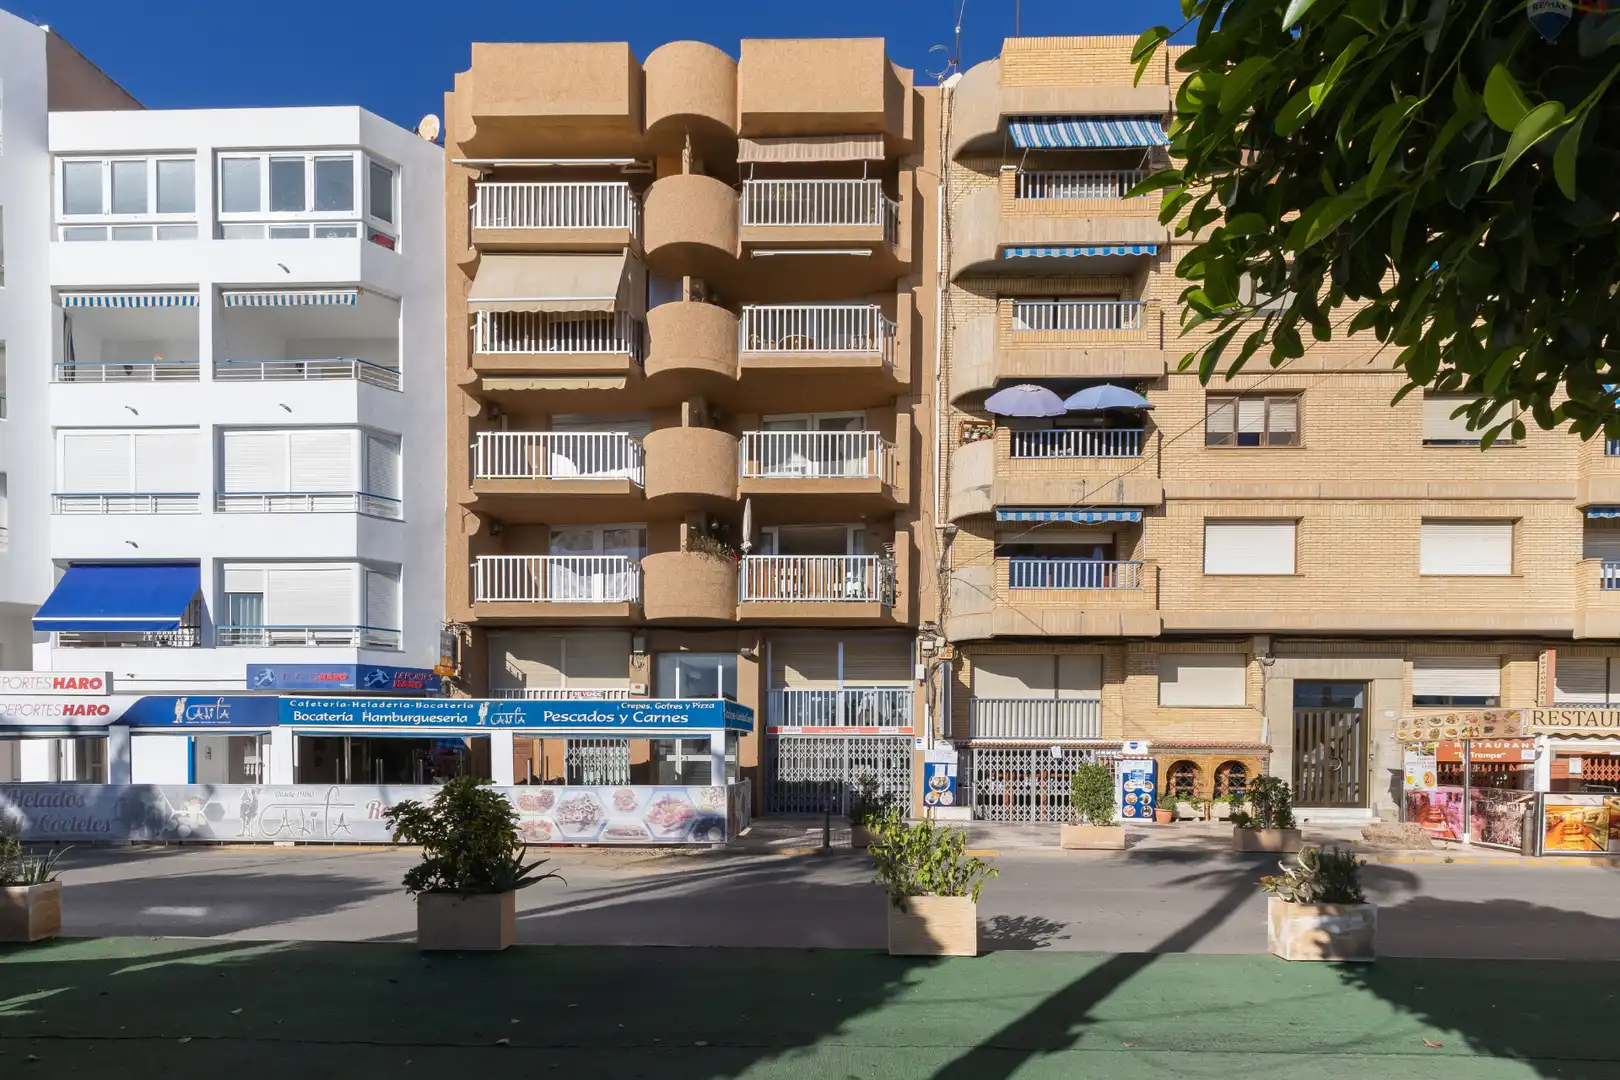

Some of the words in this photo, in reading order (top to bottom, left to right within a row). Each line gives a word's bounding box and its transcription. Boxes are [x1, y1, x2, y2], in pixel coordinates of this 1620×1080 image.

[0, 677, 52, 690] PORTES
[53, 677, 103, 690] HARO
[62, 704, 110, 716] HARO
[293, 711, 353, 722] Bocatería
[543, 710, 615, 723] Pescados
[619, 714, 628, 724] y
[633, 711, 689, 723] Carnes
[1533, 710, 1620, 727] RESTAU
[7, 788, 86, 808] Helados
